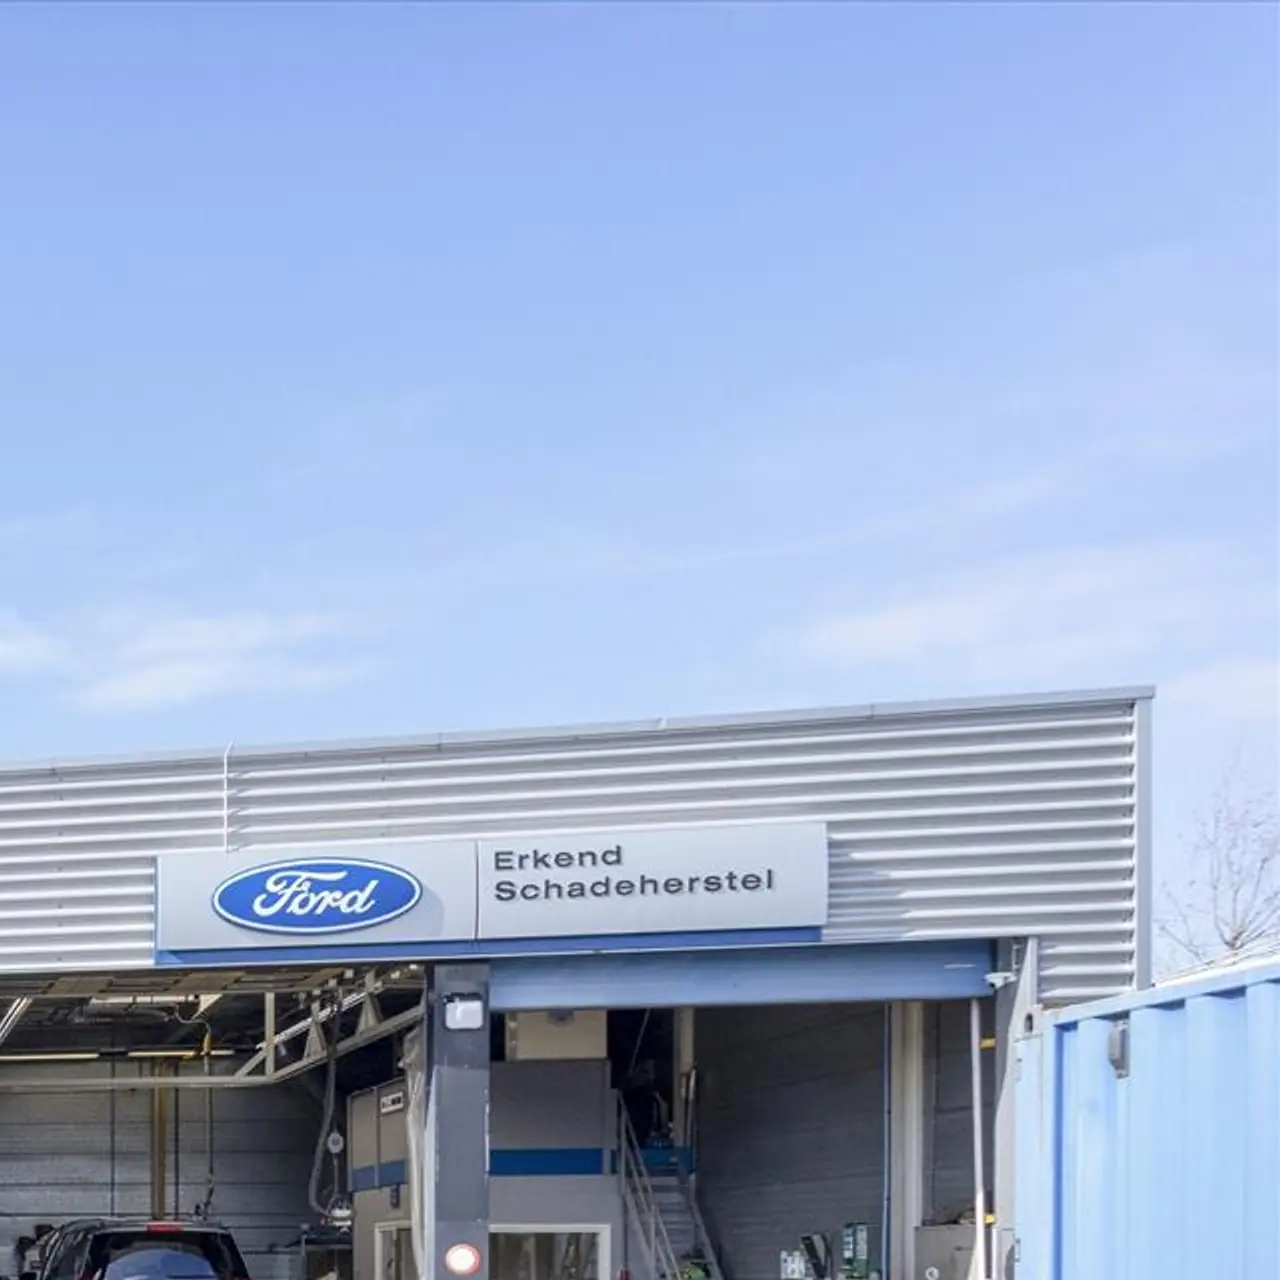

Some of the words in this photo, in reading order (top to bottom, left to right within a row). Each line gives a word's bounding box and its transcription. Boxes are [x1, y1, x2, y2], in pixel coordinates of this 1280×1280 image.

[494, 845, 623, 871] Erkend
[252, 870, 379, 917] Ford
[495, 868, 774, 902] Schadeherstel
